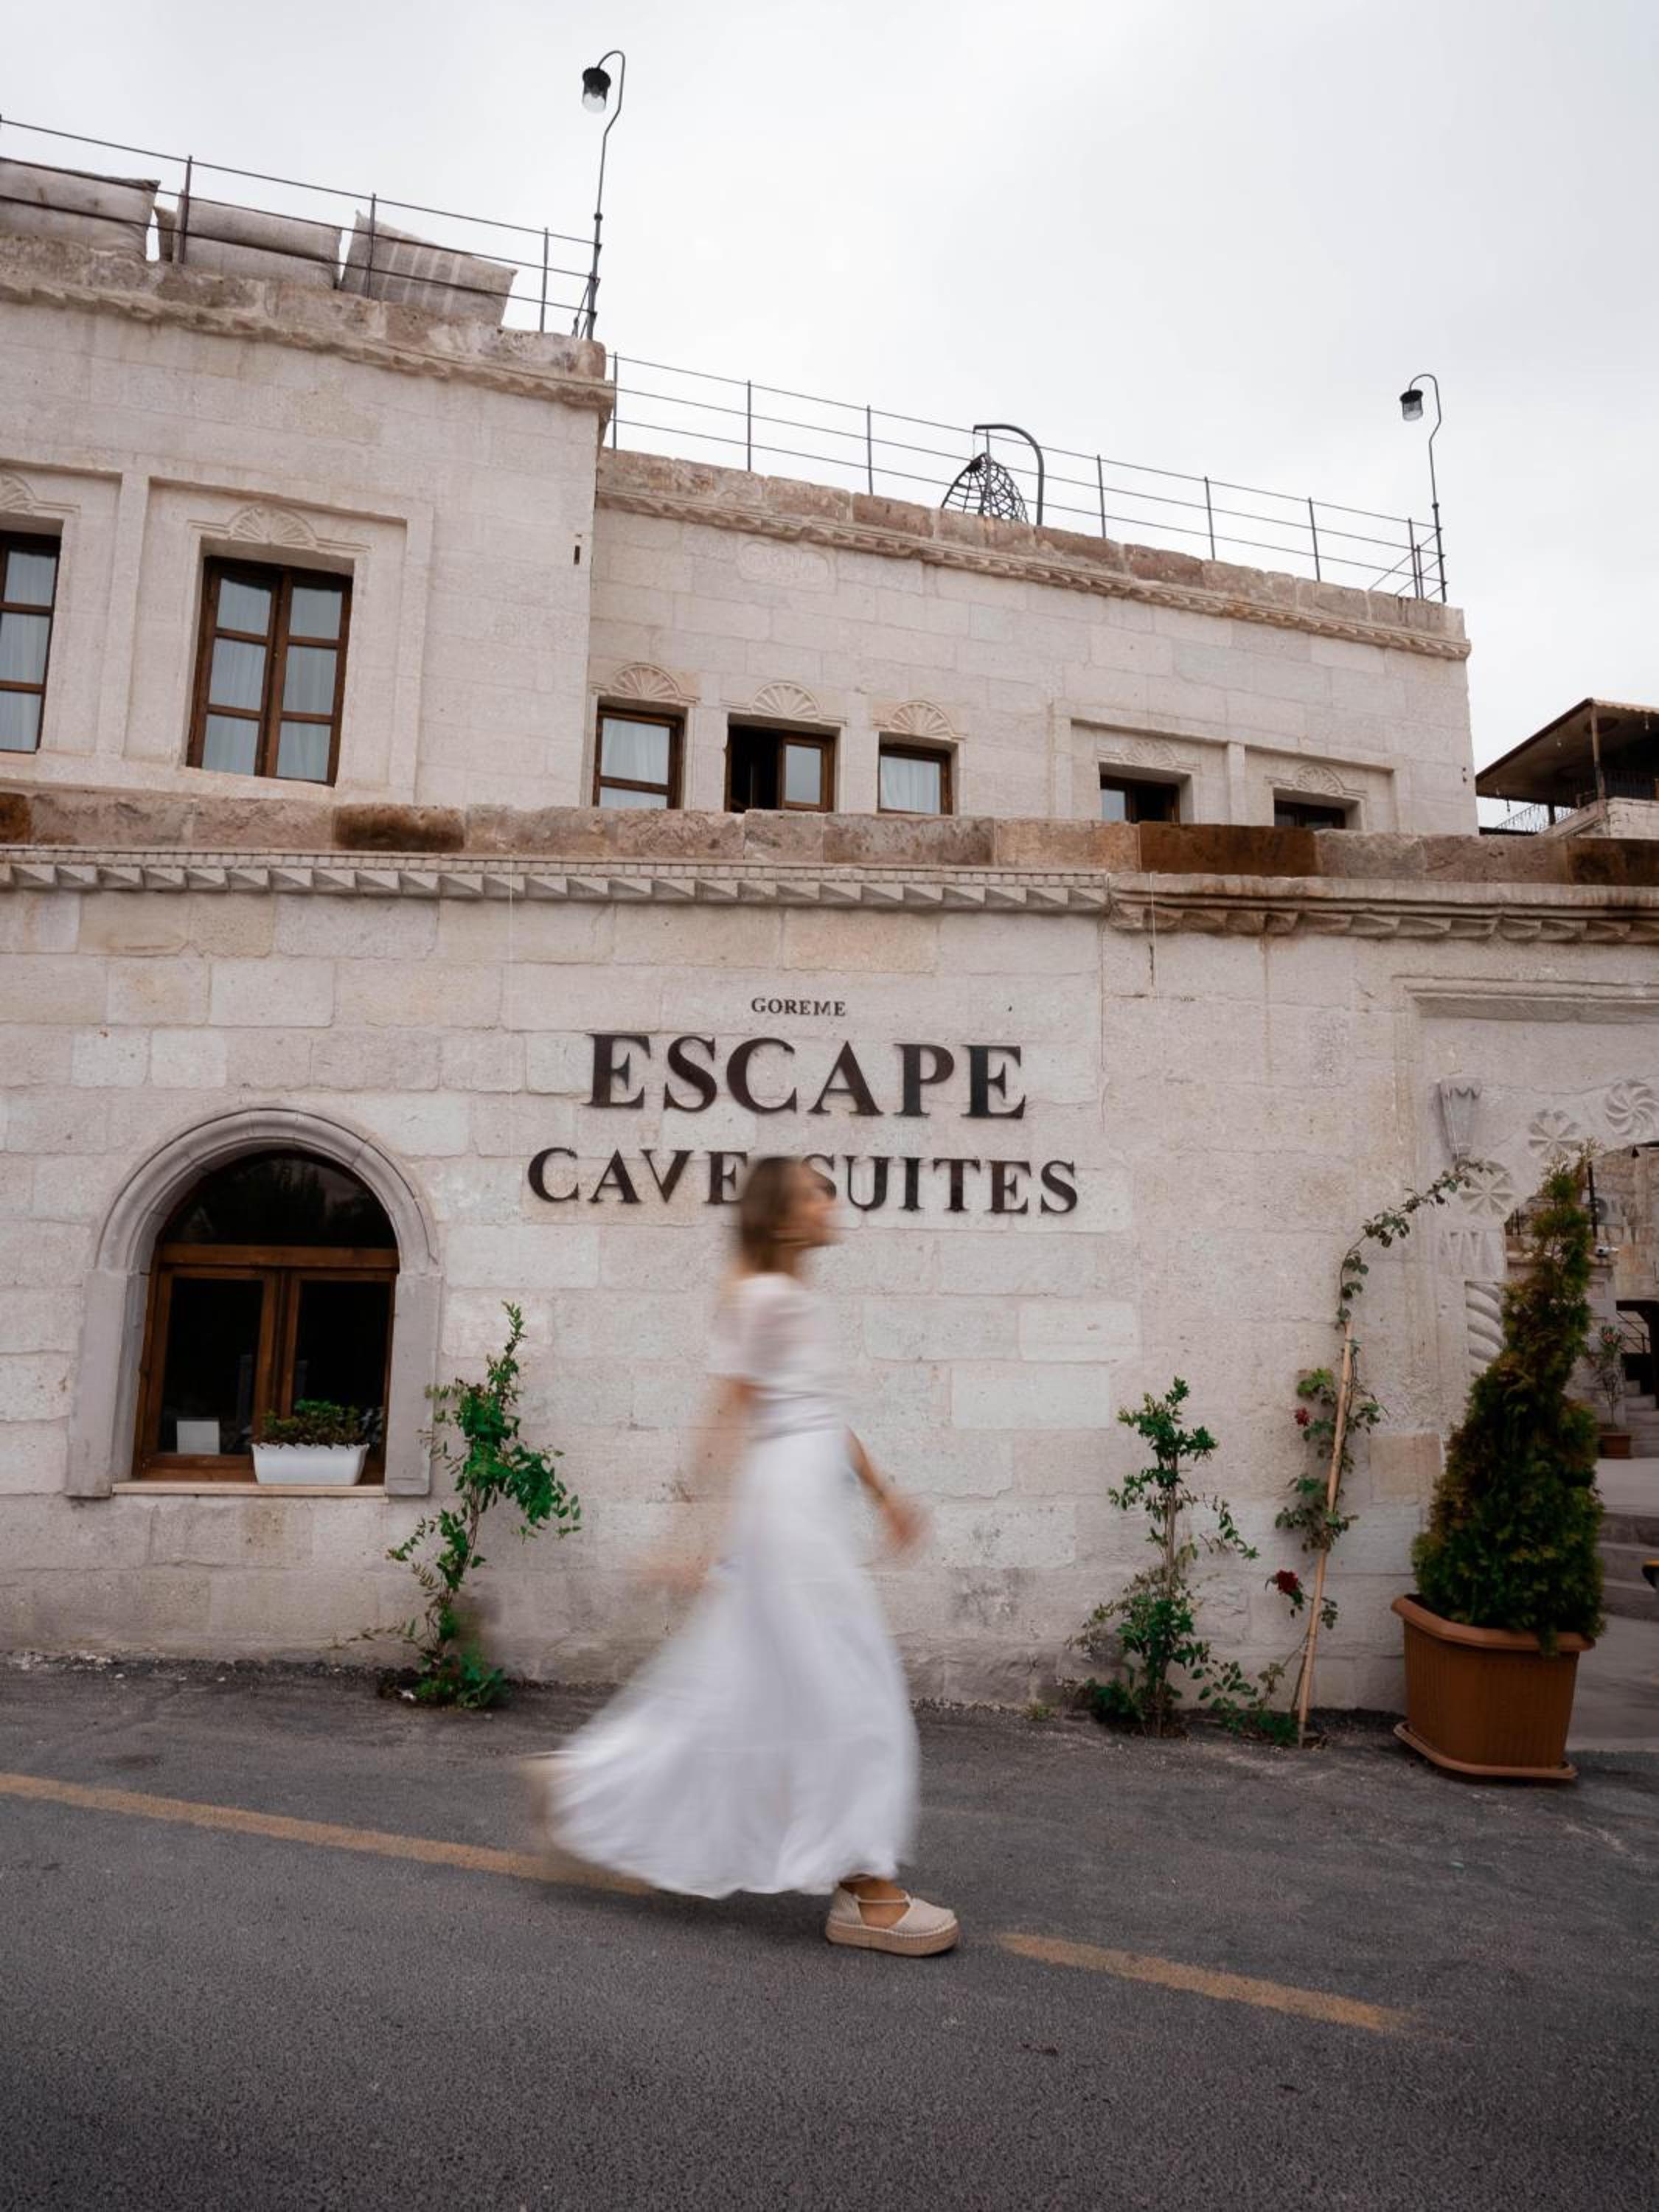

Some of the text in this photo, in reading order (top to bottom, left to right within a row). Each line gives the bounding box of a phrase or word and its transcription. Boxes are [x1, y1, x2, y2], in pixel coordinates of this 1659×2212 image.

[751, 998, 846, 1017] GOREME
[582, 1032, 1026, 1120] ESCAPE
[527, 1147, 749, 1205] CAVE
